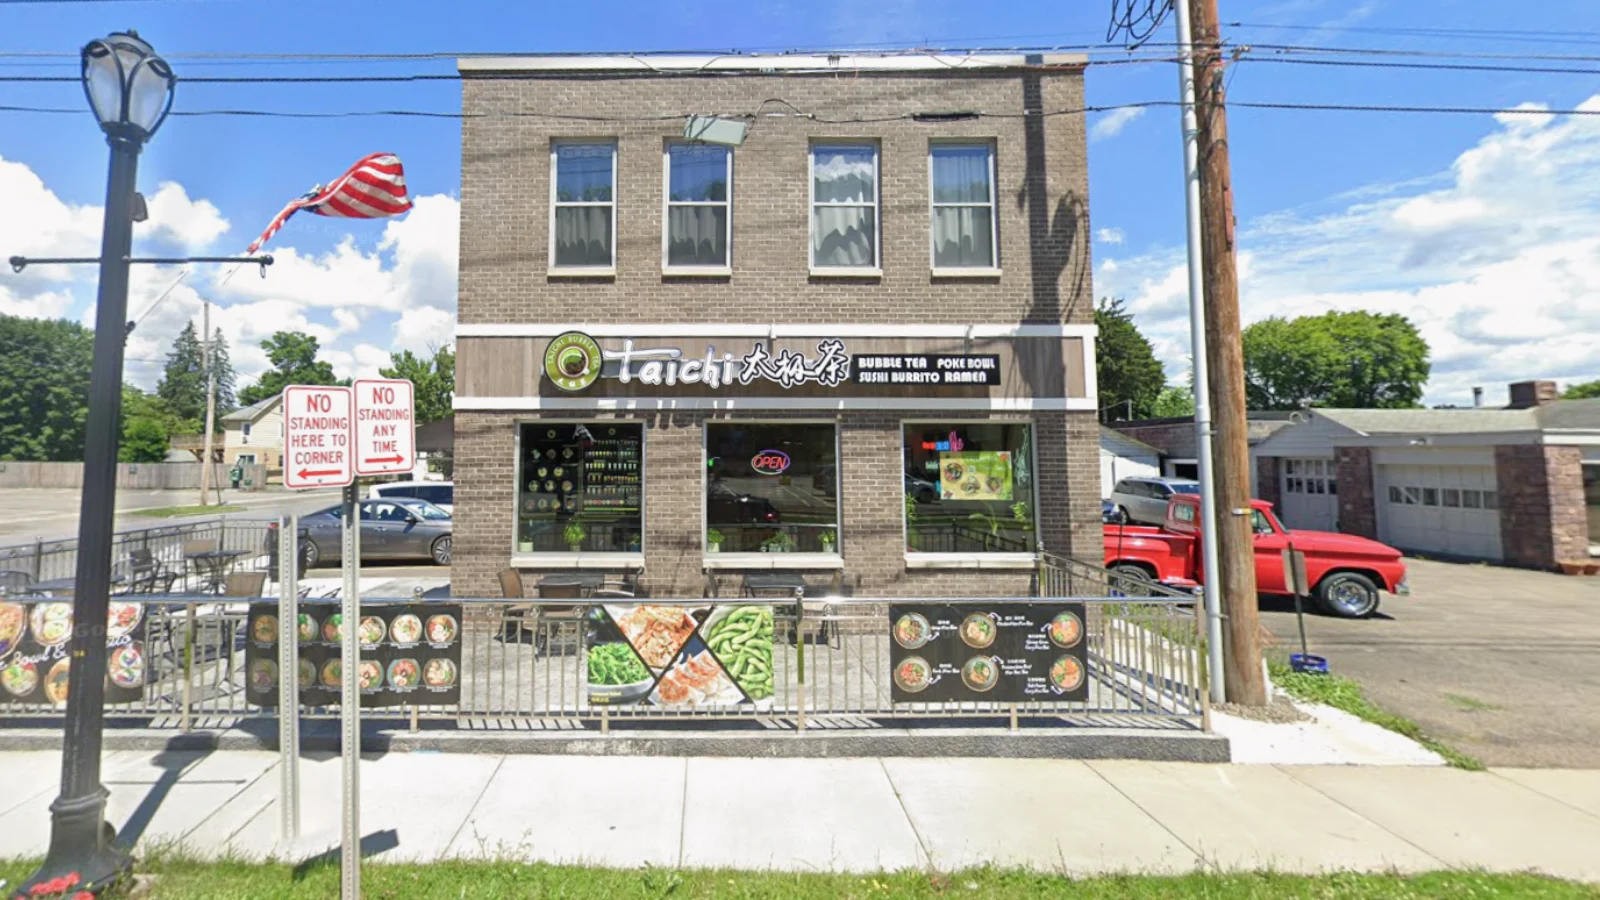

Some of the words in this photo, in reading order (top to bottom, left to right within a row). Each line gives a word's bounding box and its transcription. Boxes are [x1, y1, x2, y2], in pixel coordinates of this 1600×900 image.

[603, 338, 733, 389] Taichi
[858, 357, 902, 369] BUBBLE
[904, 357, 927, 369] TEA
[937, 358, 965, 369] POKE
[967, 358, 995, 369] BOWL
[859, 371, 889, 383] SUSHI
[891, 371, 940, 383] BURRITO
[944, 371, 987, 383] RAMEN
[372, 387, 395, 405] NO
[306, 394, 332, 413] NO
[359, 408, 410, 421] STANDING
[290, 417, 348, 430] STANDING
[372, 424, 396, 437] ANY
[291, 434, 325, 447] HERE
[332, 434, 347, 447] TO
[372, 440, 398, 453] TIME
[295, 451, 343, 465] CORNER
[753, 456, 787, 470] OPEN
